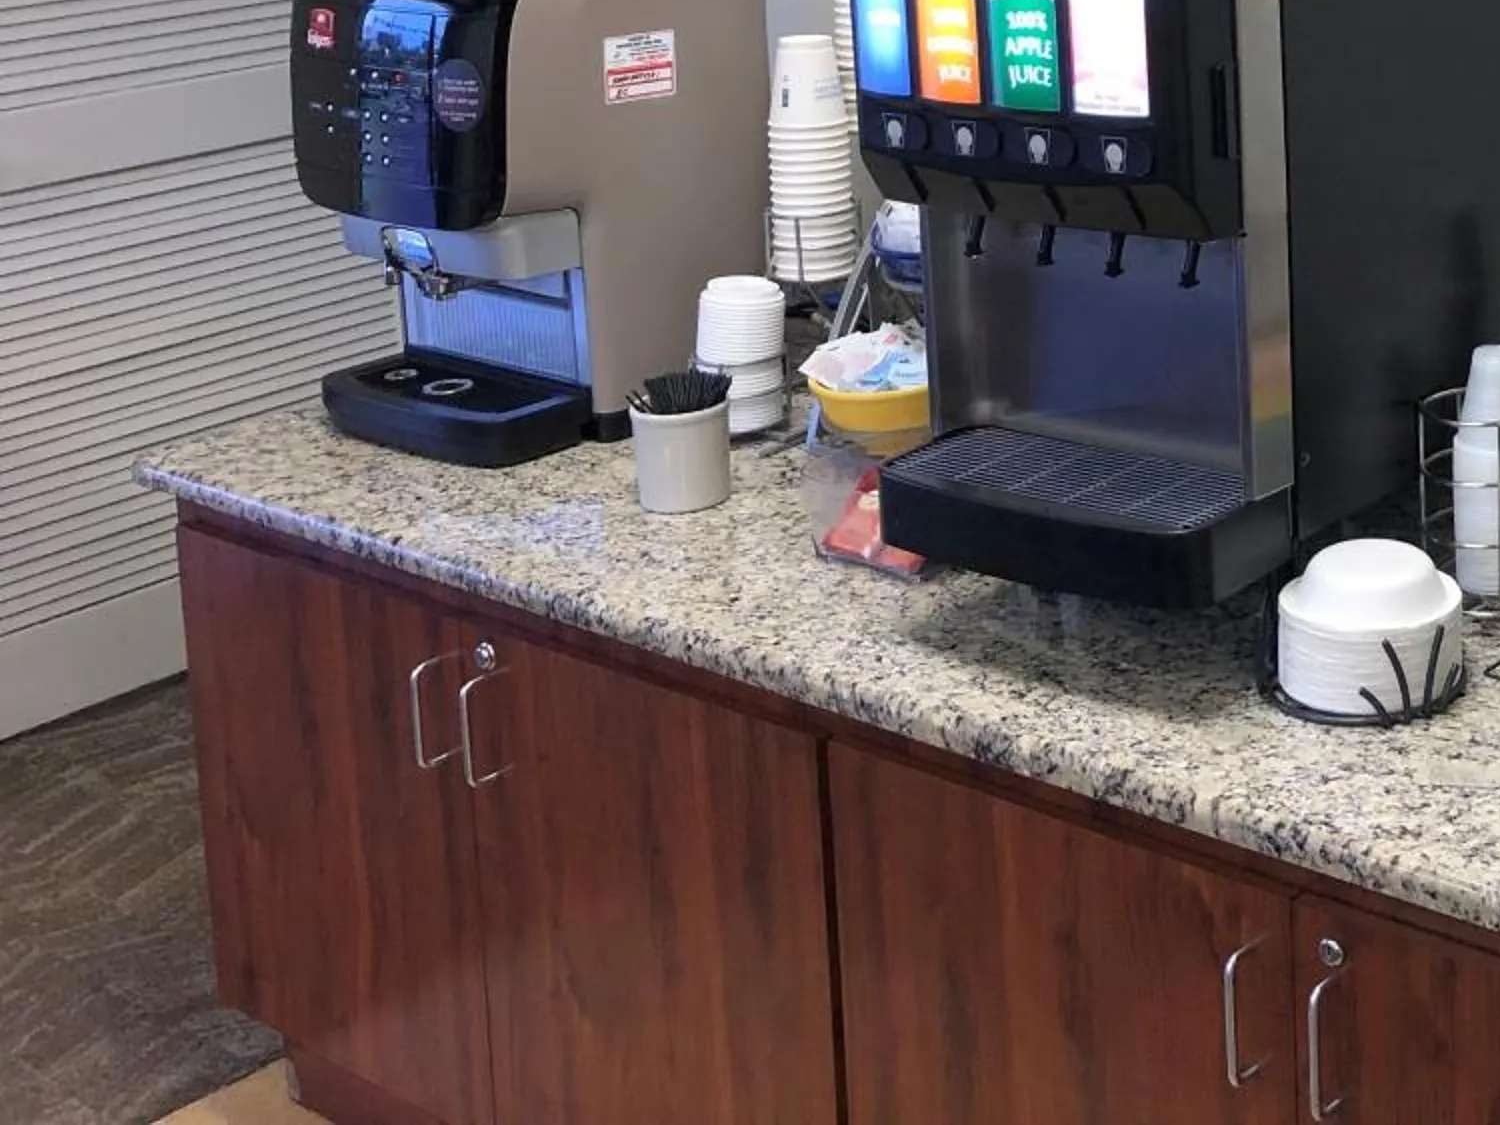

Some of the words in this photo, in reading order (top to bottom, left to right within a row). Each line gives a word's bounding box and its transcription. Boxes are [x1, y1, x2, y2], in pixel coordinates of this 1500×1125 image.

[1005, 10, 1048, 32] 100%
[1004, 35, 1053, 59] APPLE
[1008, 64, 1053, 89] JUICE
